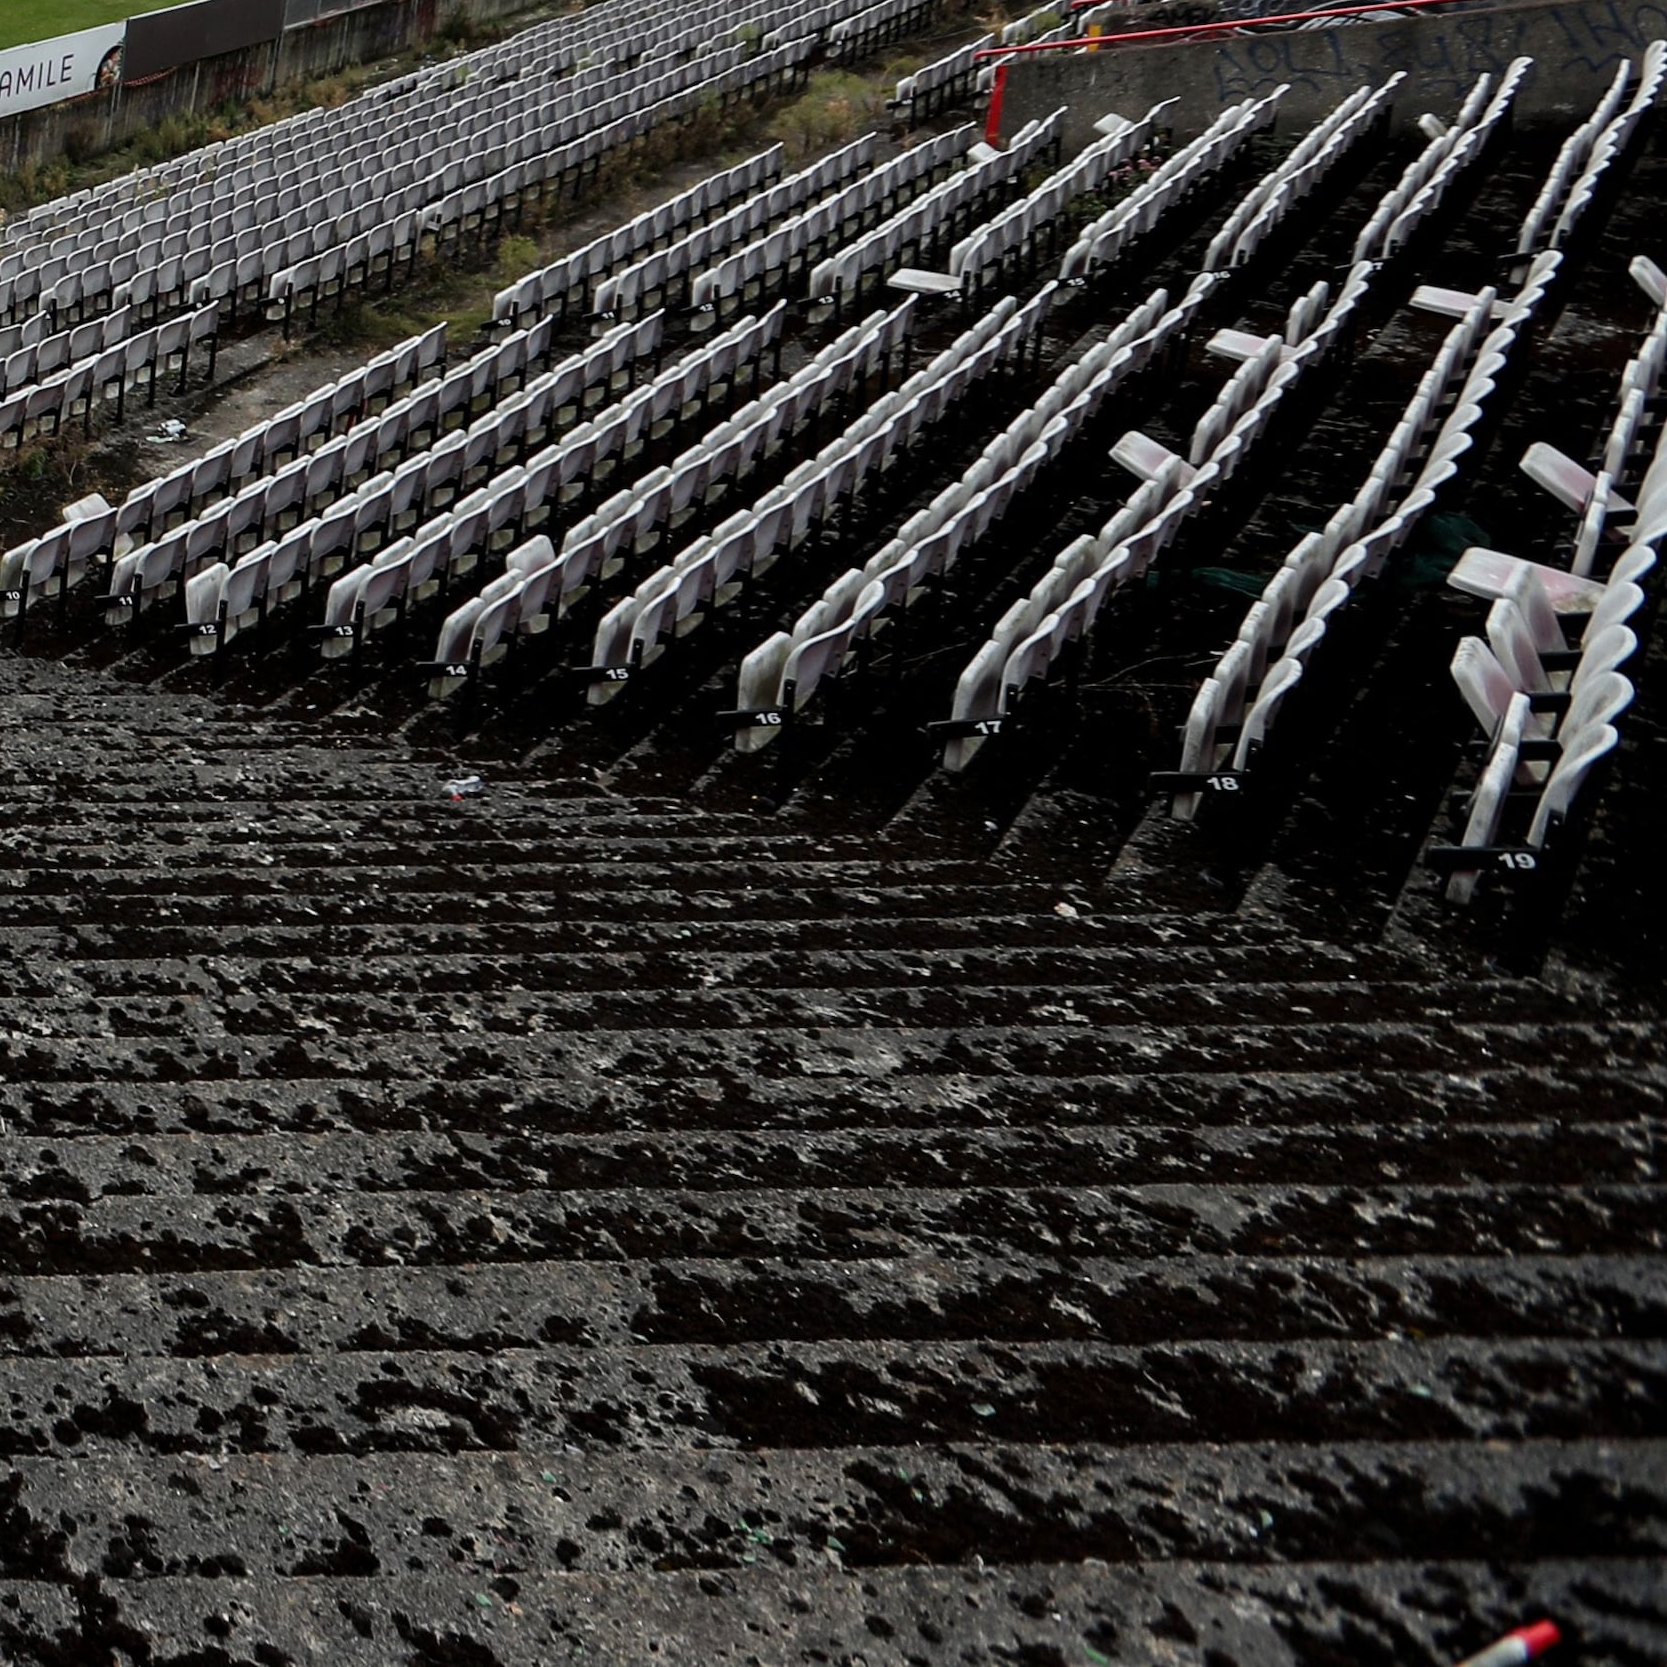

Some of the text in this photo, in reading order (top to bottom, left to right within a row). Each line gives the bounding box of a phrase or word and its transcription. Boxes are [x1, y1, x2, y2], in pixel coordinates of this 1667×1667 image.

[1066, 276, 1086, 287] 15
[601, 310, 617, 320] 11
[497, 317, 512, 327] 10
[5, 590, 21, 600] 10
[118, 595, 134, 606] 11
[198, 623, 218, 635] 12
[334, 624, 354, 637] 13
[445, 664, 467, 676] 14
[605, 667, 630, 680] 15
[754, 711, 782, 725] 16
[973, 718, 1002, 736] 17
[1206, 774, 1240, 792] 18
[1496, 850, 1537, 872] 19
